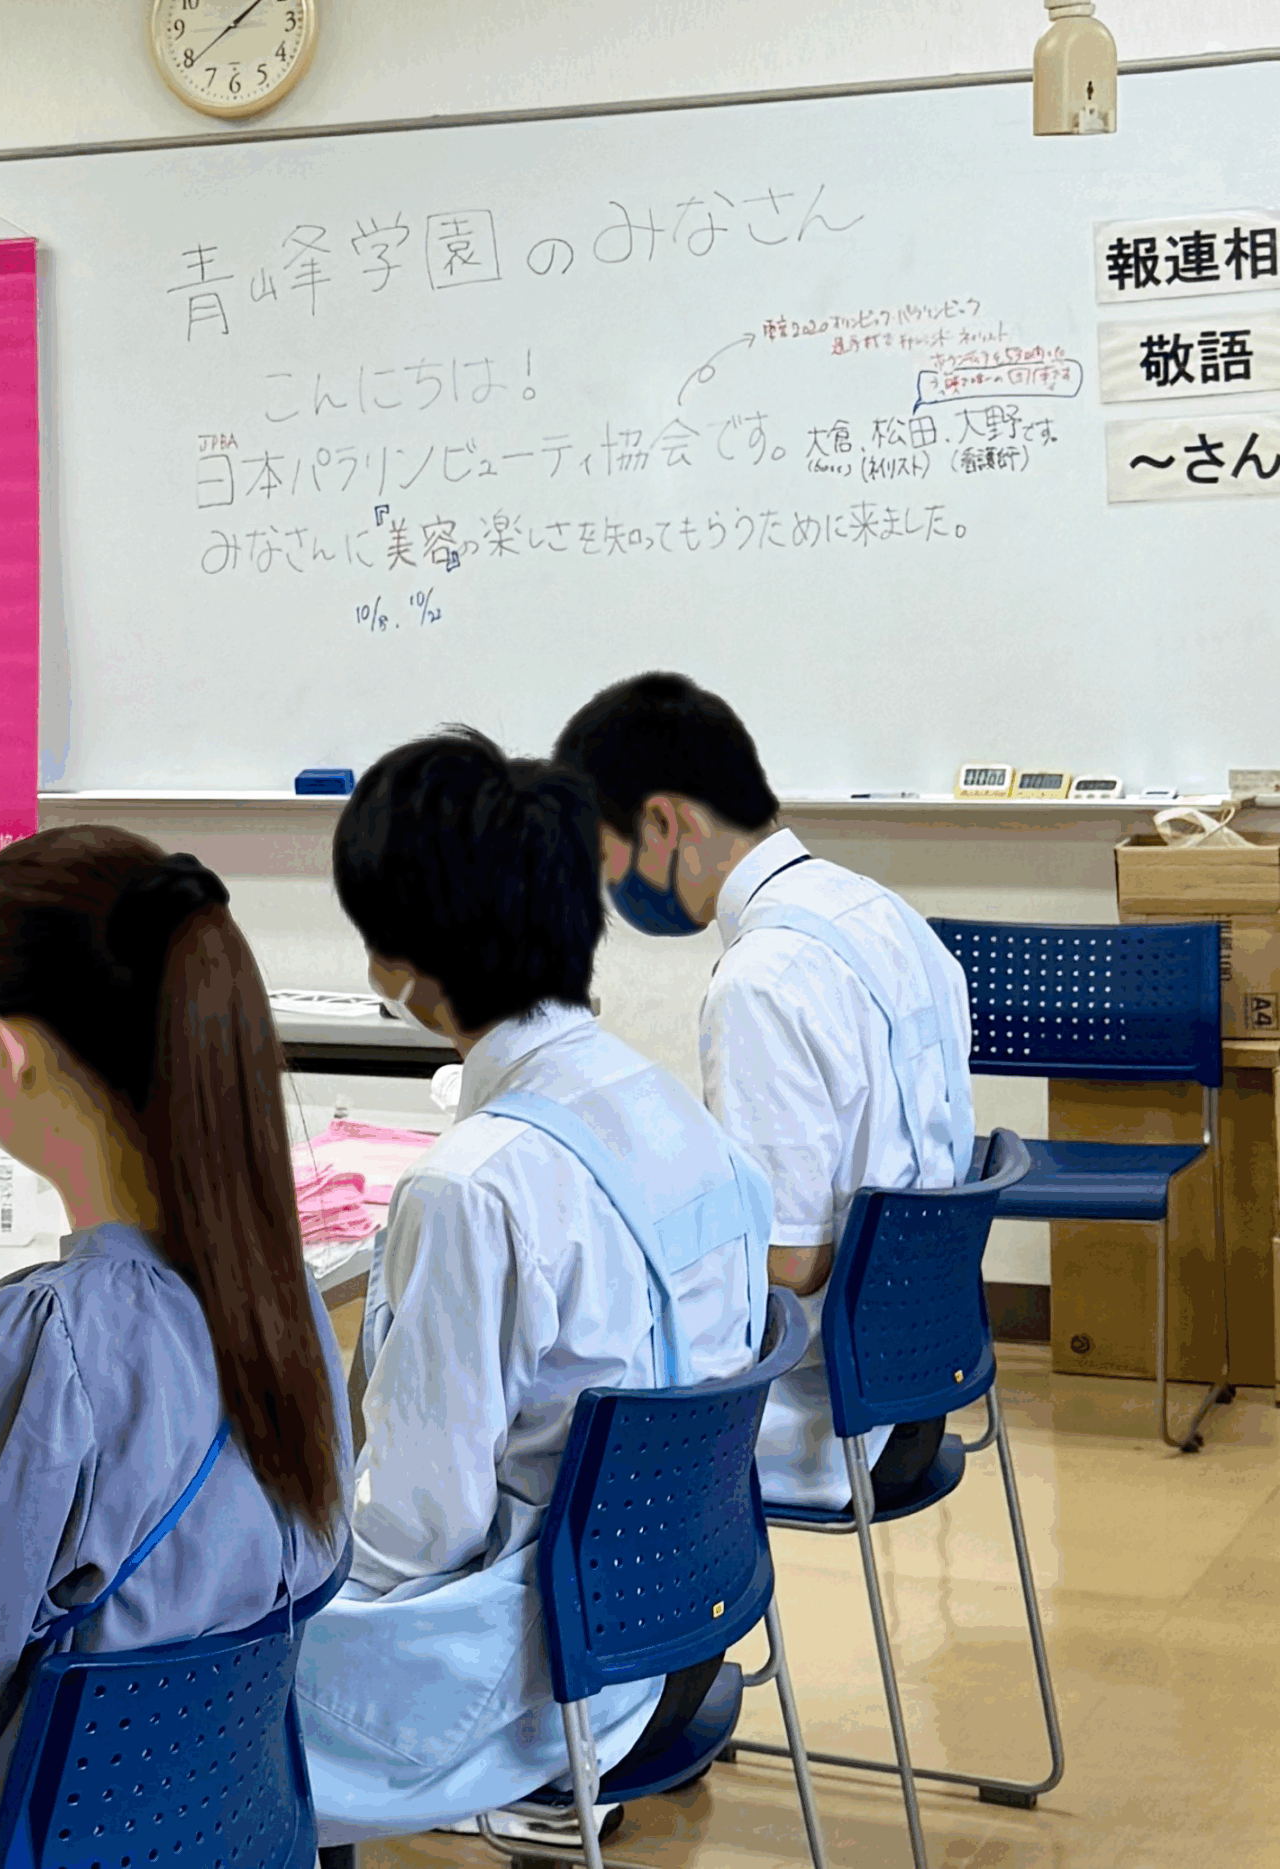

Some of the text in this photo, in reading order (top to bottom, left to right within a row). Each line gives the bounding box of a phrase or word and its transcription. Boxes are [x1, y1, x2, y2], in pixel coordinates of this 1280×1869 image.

[173, 18, 186, 41] 9
[284, 10, 297, 32] 3
[183, 48, 195, 69] 8
[275, 40, 287, 62] 4
[205, 67, 218, 88] 7
[229, 72, 242, 93] 6
[256, 63, 268, 85] 5
[1106, 227, 1278, 291] 報連相
[1140, 330, 1253, 387] 敬語
[1250, 996, 1272, 1027] A4
